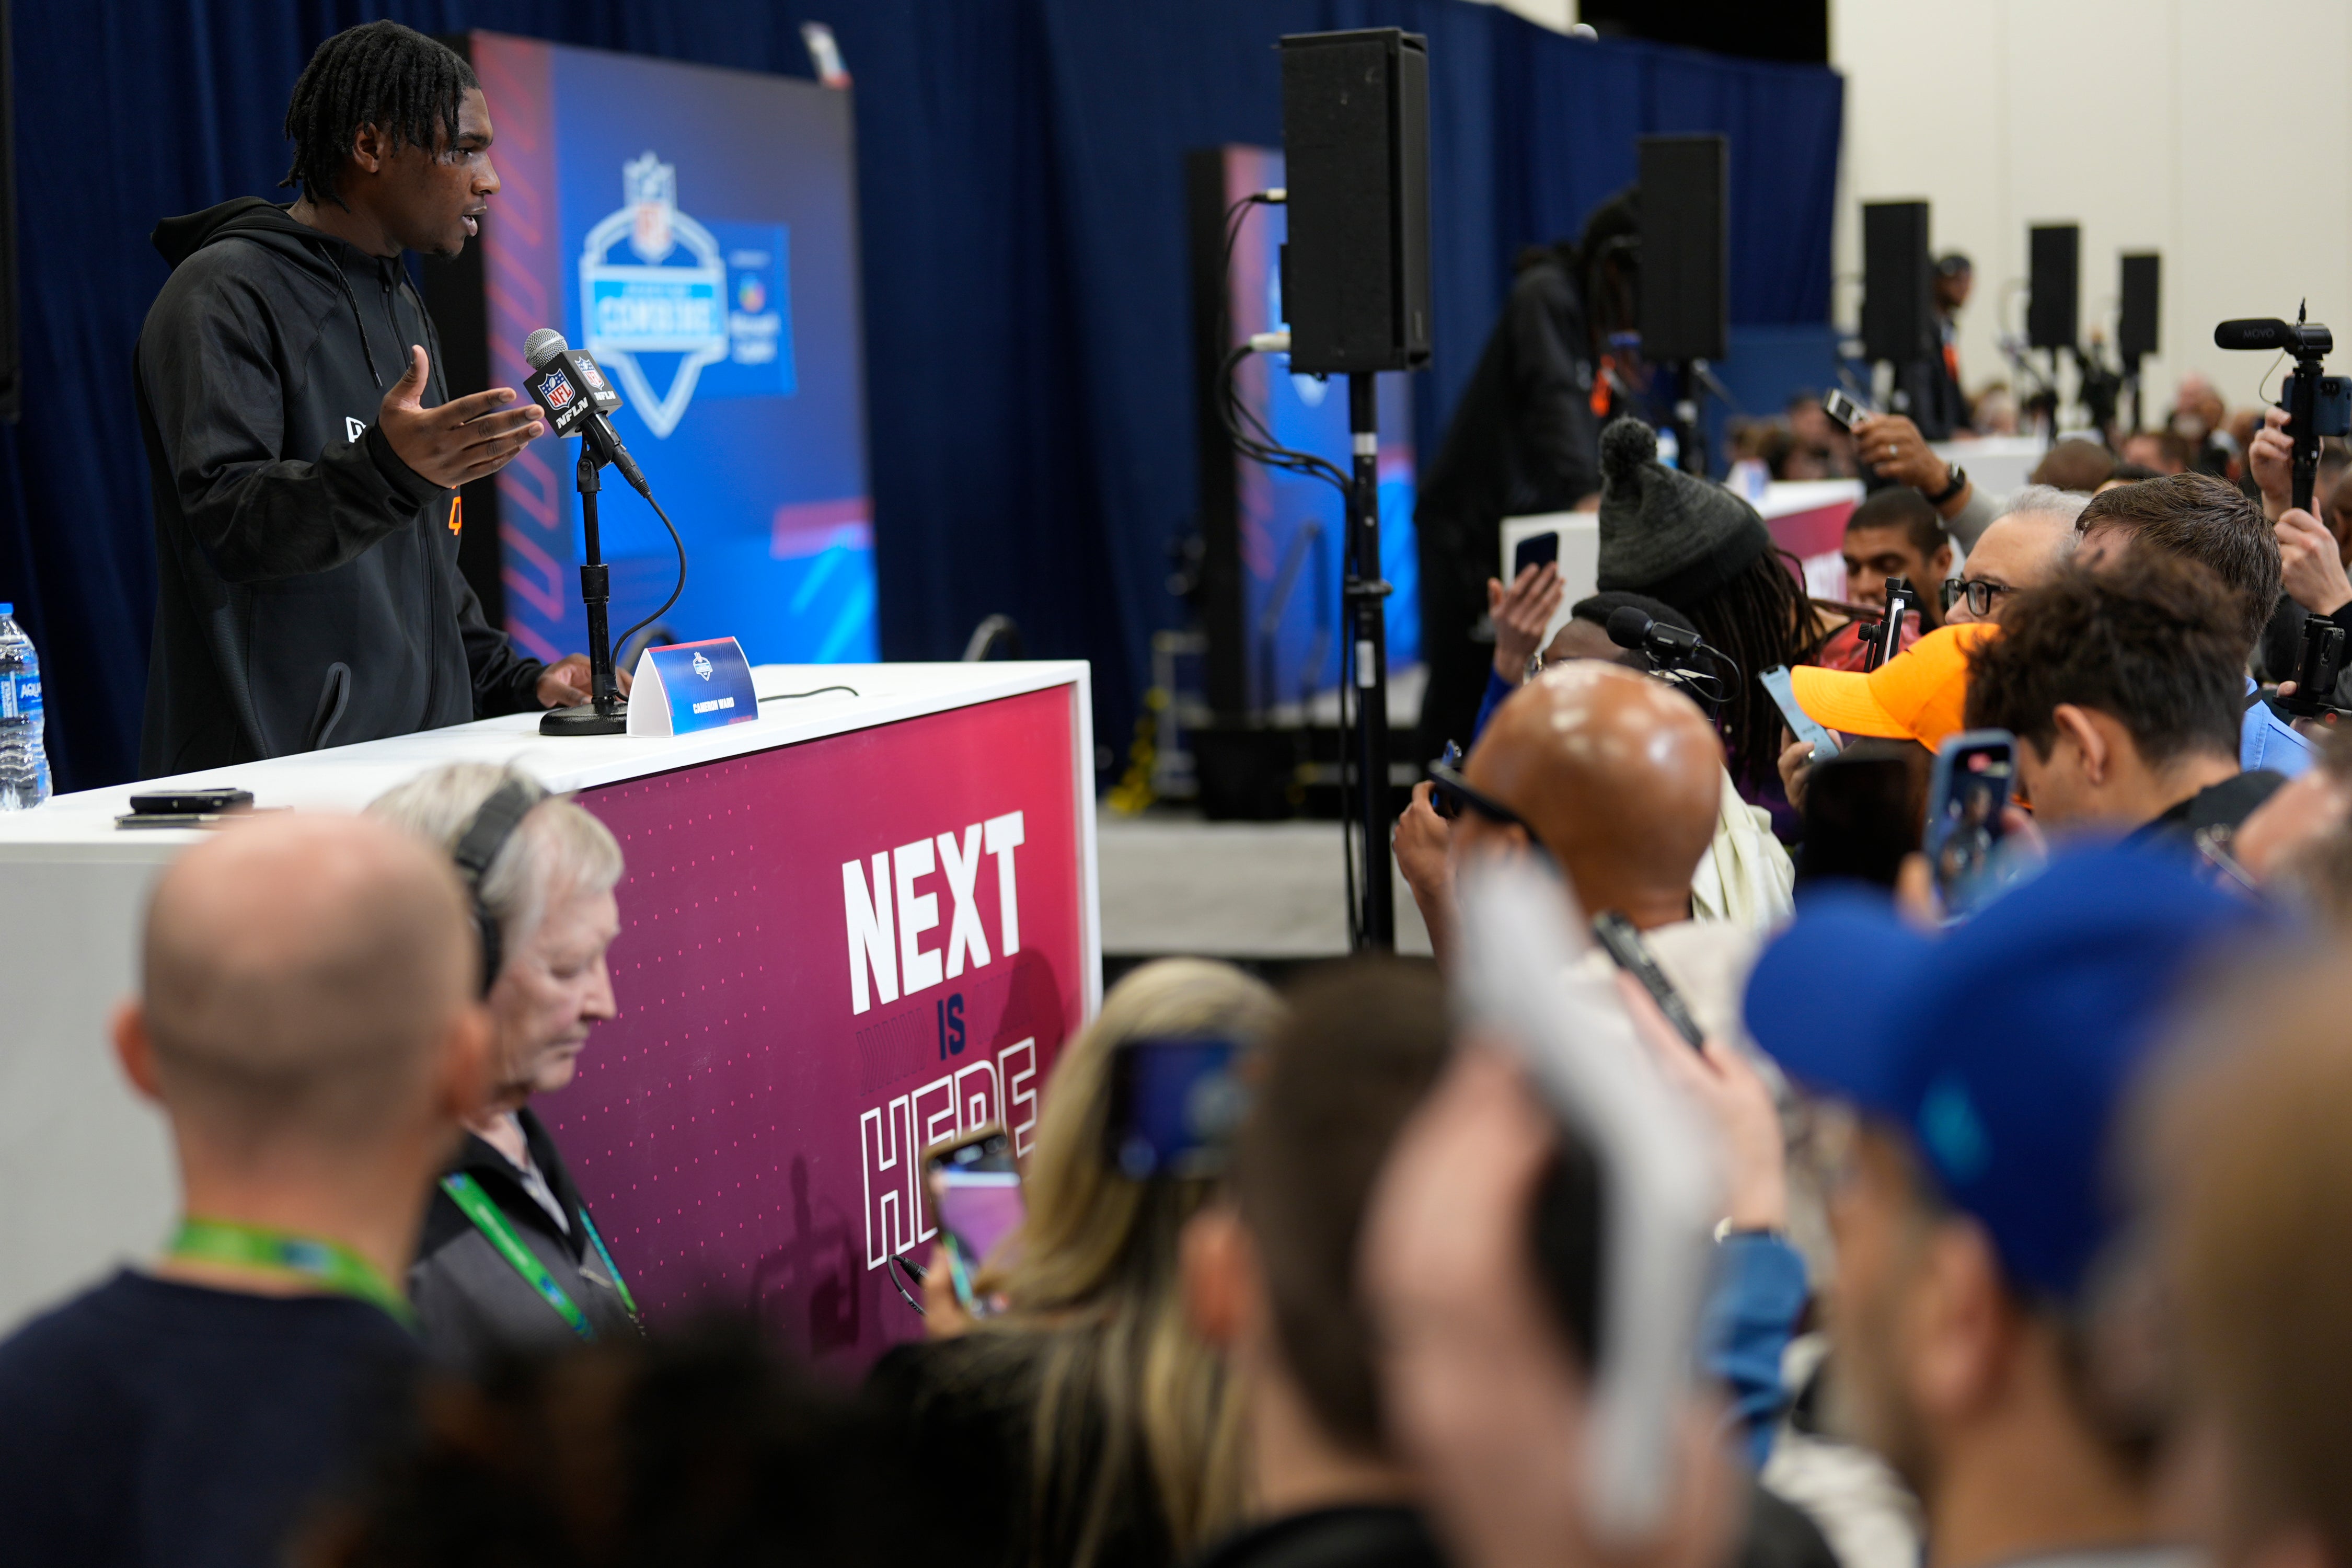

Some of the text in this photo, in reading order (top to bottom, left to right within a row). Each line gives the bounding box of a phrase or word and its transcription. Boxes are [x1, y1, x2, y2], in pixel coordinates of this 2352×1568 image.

[2243, 328, 2274, 339] MOVO
[585, 372, 601, 385] NFL
[549, 385, 572, 406] NFL
[595, 391, 616, 400] NFLN
[556, 397, 589, 429] NFLN
[693, 697, 734, 714] CAMERON WARD
[841, 810, 1025, 1016] NEXT
[937, 993, 966, 1061] IS
